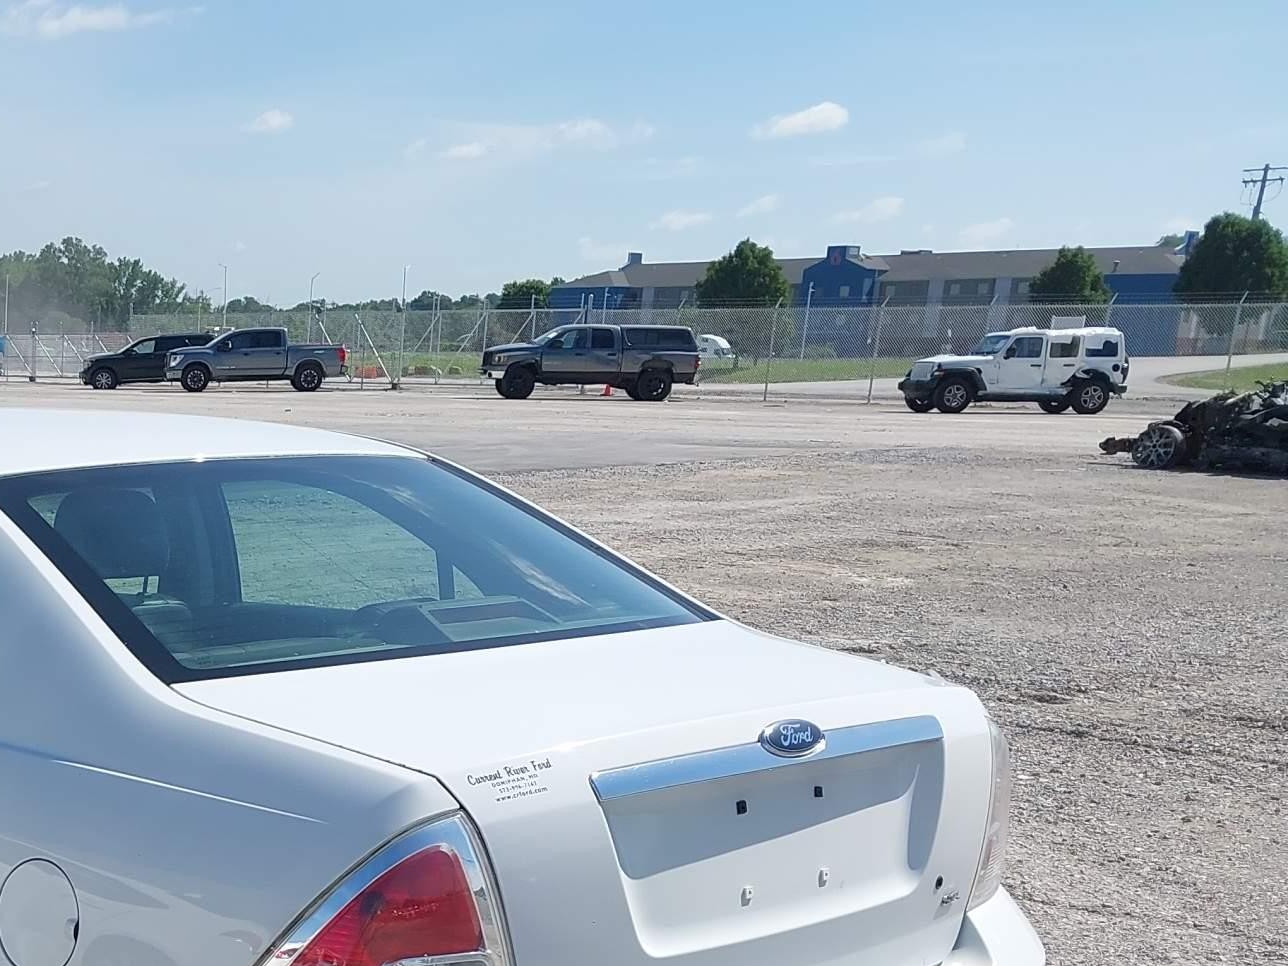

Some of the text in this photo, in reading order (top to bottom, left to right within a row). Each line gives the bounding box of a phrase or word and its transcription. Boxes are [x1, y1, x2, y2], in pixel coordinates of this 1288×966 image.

[780, 723, 813, 746] Ford
[467, 758, 552, 786] Current River Ford
